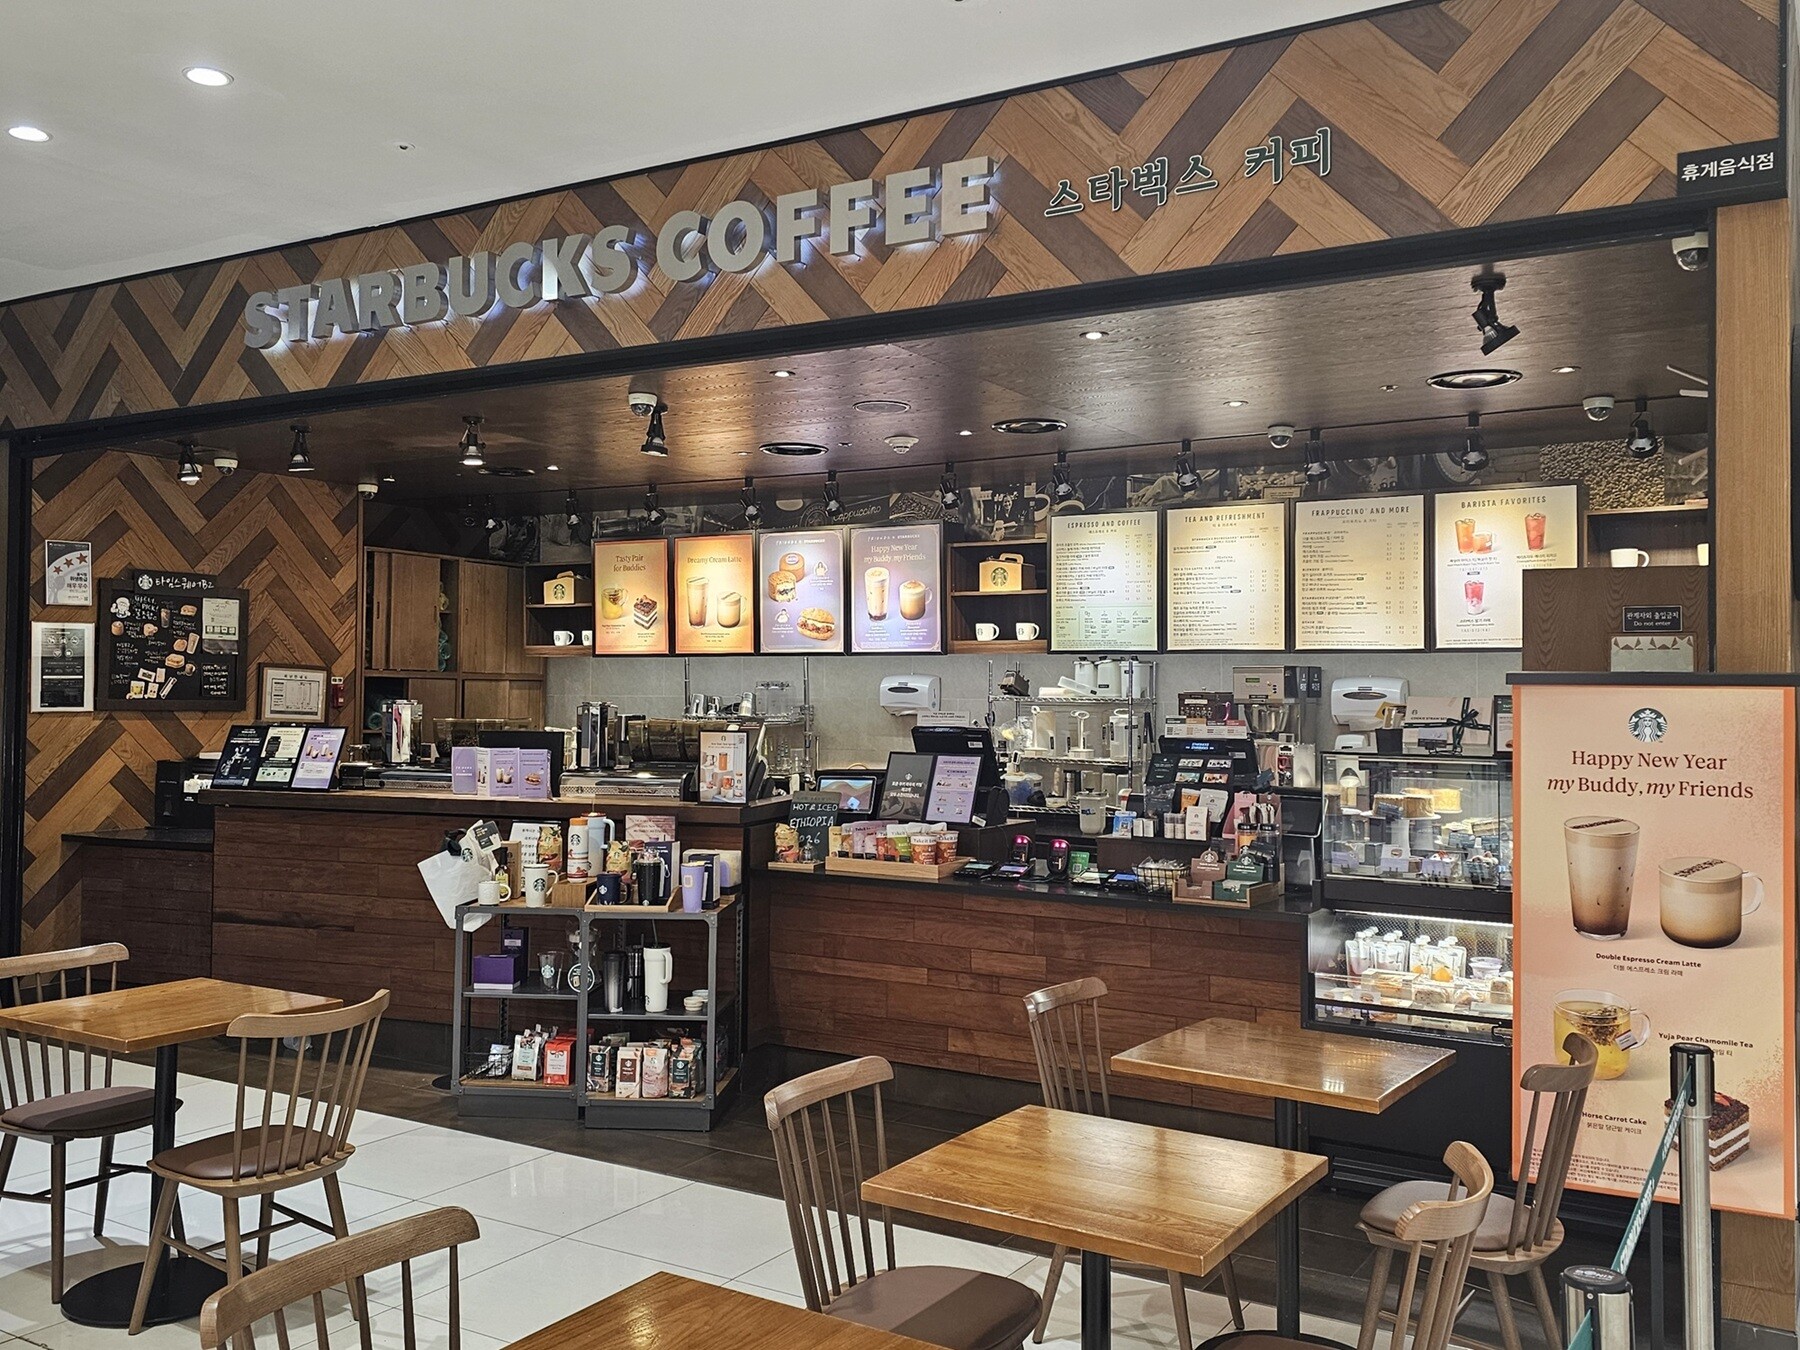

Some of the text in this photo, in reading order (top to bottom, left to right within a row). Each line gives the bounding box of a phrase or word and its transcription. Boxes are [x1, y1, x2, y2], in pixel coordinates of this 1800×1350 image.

[1044, 127, 1331, 217] 스타벅스 커피
[1681, 152, 1774, 181] 휴게음식점
[244, 156, 999, 349] STARBUCKS COFFEE
[1461, 496, 1547, 509] BARISTA FAVORITES
[1216, 512, 1265, 521] REFRESHMENT
[1067, 520, 1099, 528] ESPRESSO
[871, 545, 890, 553] Happy
[904, 543, 918, 551] Year
[687, 557, 708, 565] Dreamy
[727, 555, 742, 563] Latte
[903, 552, 926, 561] Friends
[613, 564, 646, 572] for Buddies
[1654, 611, 1679, 620] 출입금지
[1571, 750, 1728, 770] Happy New Year
[1547, 777, 1754, 798] my Buddy, my Friends
[792, 803, 809, 811] HOT
[817, 803, 838, 811] ICED
[790, 815, 834, 830] ETHIOPIA
[1596, 953, 1702, 968] Double Espresso Cream Latte
[1613, 964, 1625, 972] 더블
[1626, 965, 1656, 975] 에스프레소
[1657, 968, 1670, 976] 크림
[1658, 1032, 1675, 1041] Yuja
[1676, 1034, 1694, 1043] Pear
[1695, 1036, 1739, 1047] Chamomile
[1582, 1111, 1647, 1126] Horse Carrot Cake
[1625, 1126, 1642, 1135] 케이크
